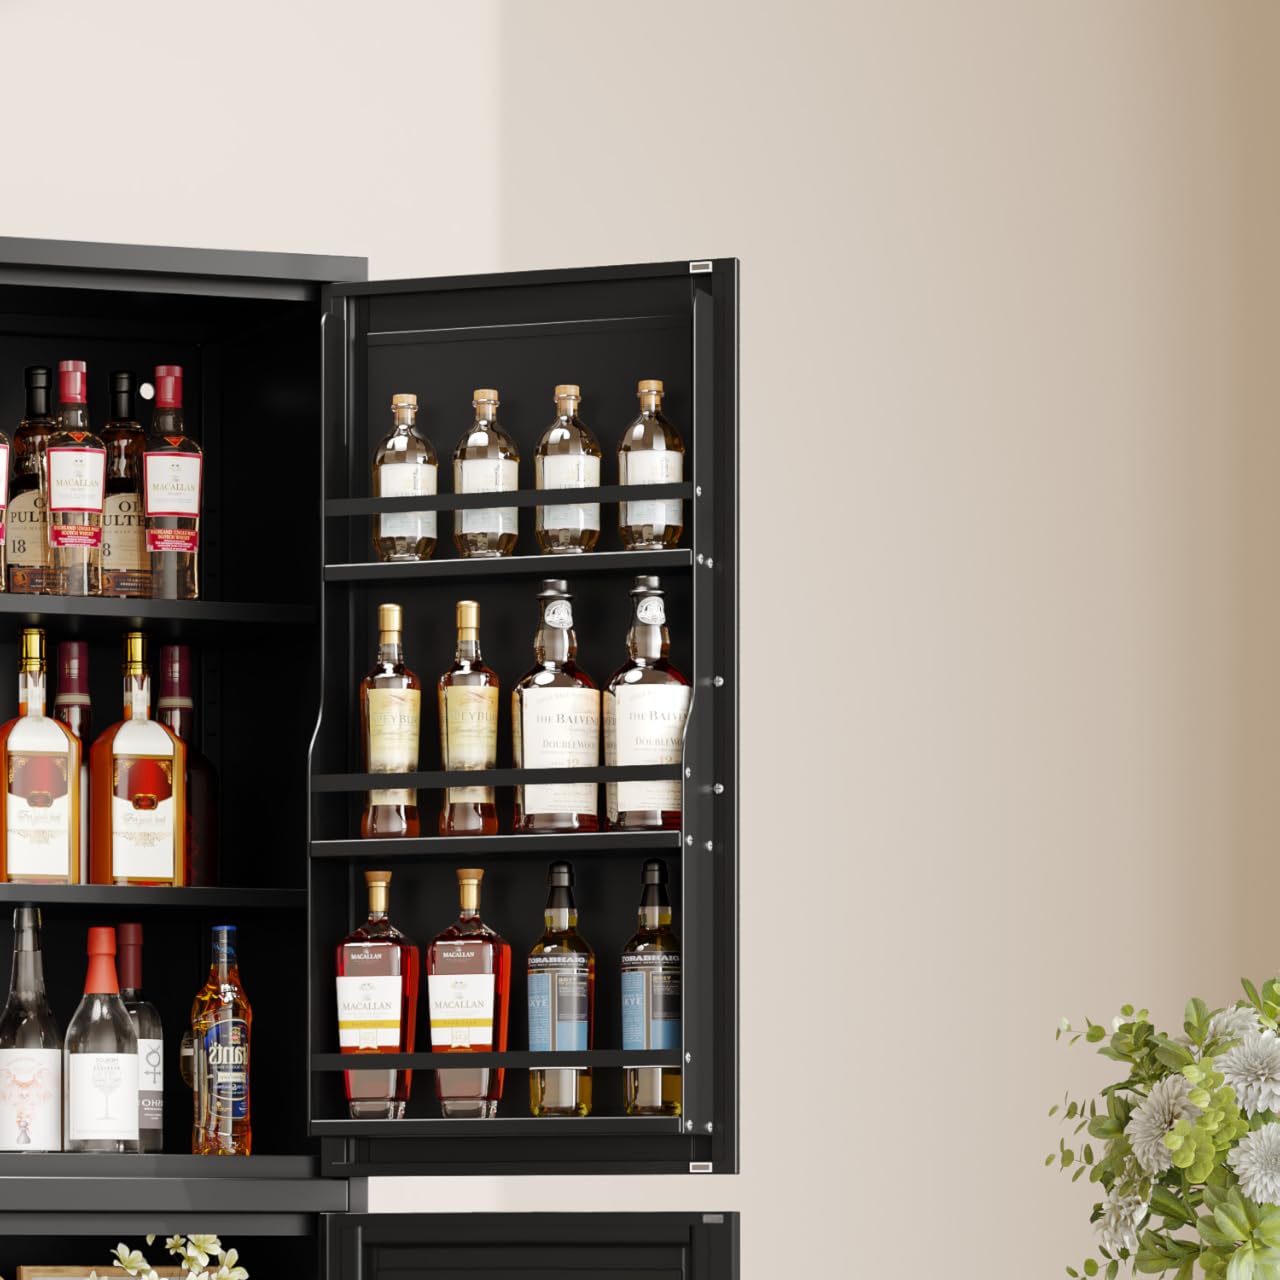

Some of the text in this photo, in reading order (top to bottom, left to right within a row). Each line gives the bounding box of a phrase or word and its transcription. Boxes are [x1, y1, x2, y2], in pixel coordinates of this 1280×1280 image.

[12, 539, 26, 553] 18
[342, 1001, 392, 1011] MACALLAN
[434, 1000, 485, 1009] MACALLAN
